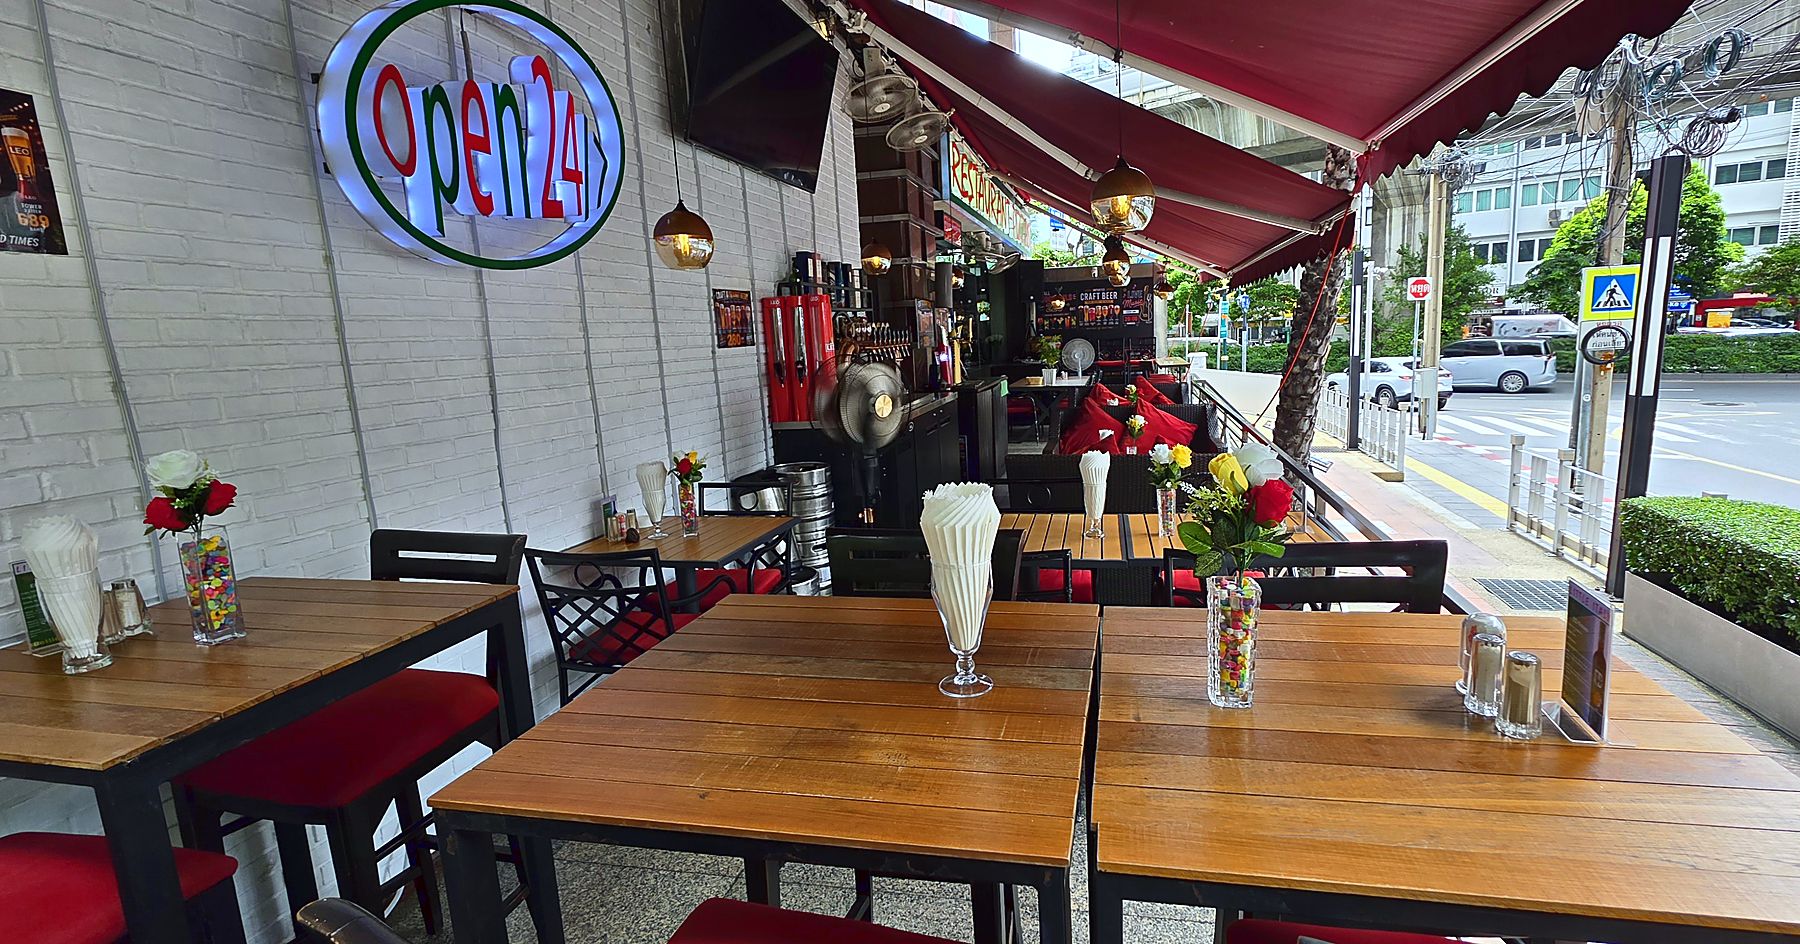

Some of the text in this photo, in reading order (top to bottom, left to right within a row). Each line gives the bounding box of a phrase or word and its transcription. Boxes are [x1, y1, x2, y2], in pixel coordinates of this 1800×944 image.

[10, 146, 30, 156] LEO
[18, 213, 49, 228] 689
[9, 235, 39, 247] TIMES
[1080, 291, 1100, 301] CRAFT
[1101, 291, 1118, 300] BEER
